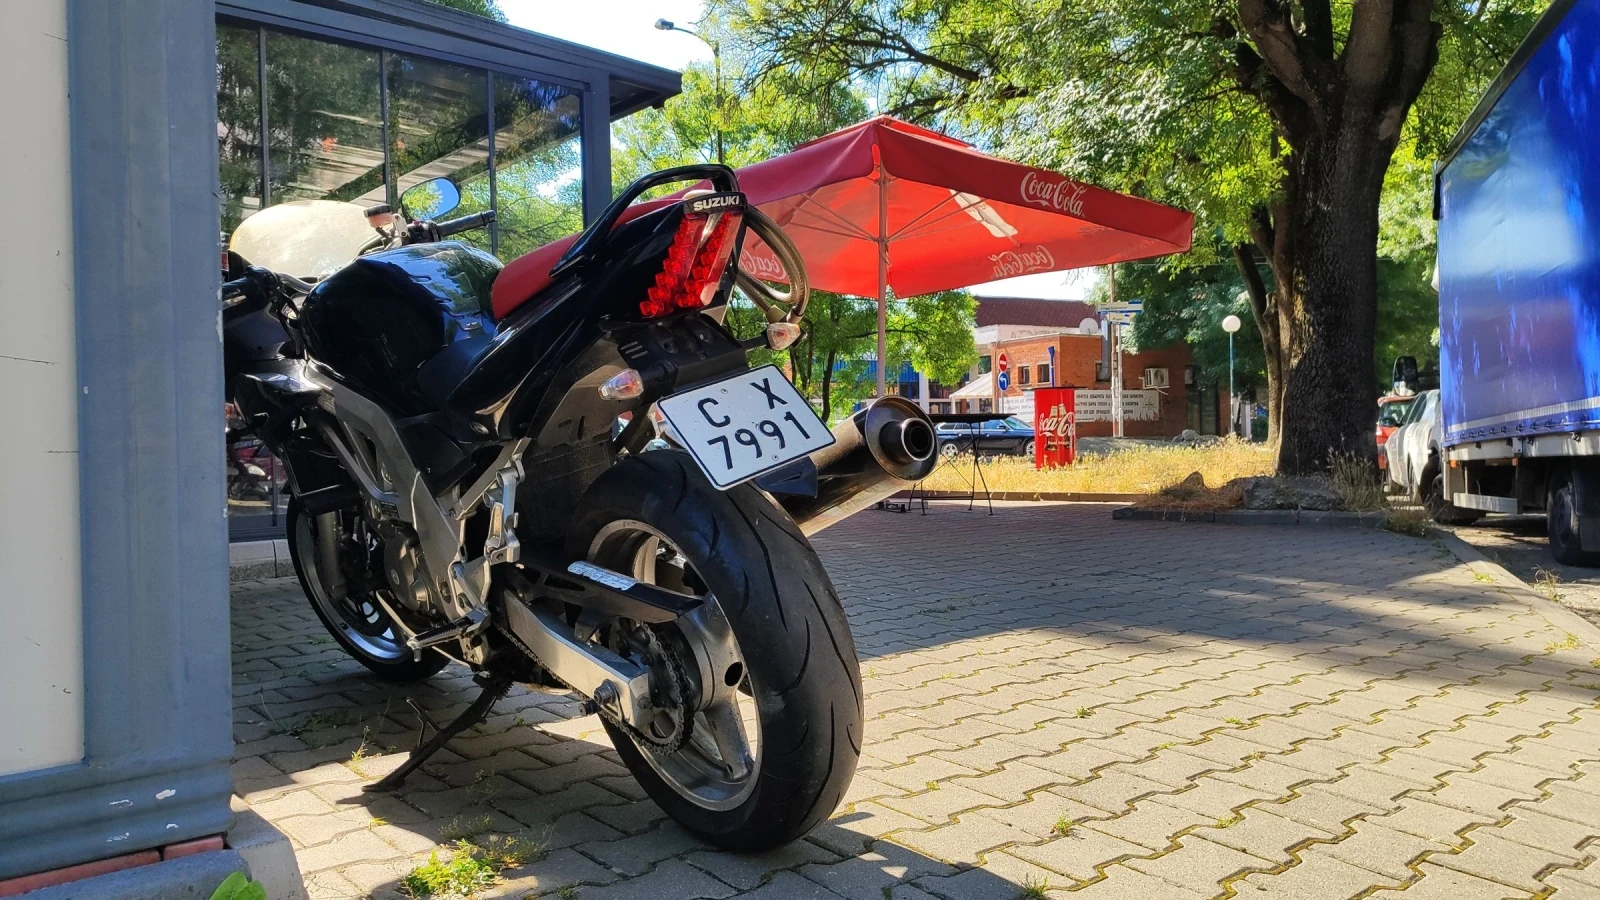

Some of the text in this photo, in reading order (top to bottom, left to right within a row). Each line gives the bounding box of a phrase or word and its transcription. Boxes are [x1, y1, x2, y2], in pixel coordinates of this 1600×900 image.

[693, 195, 740, 212] SUZUKI
[1021, 171, 1087, 216] Coca-Cola
[697, 377, 788, 428] C X
[871, 386, 899, 396] БЗАР
[707, 411, 811, 470] 7991
